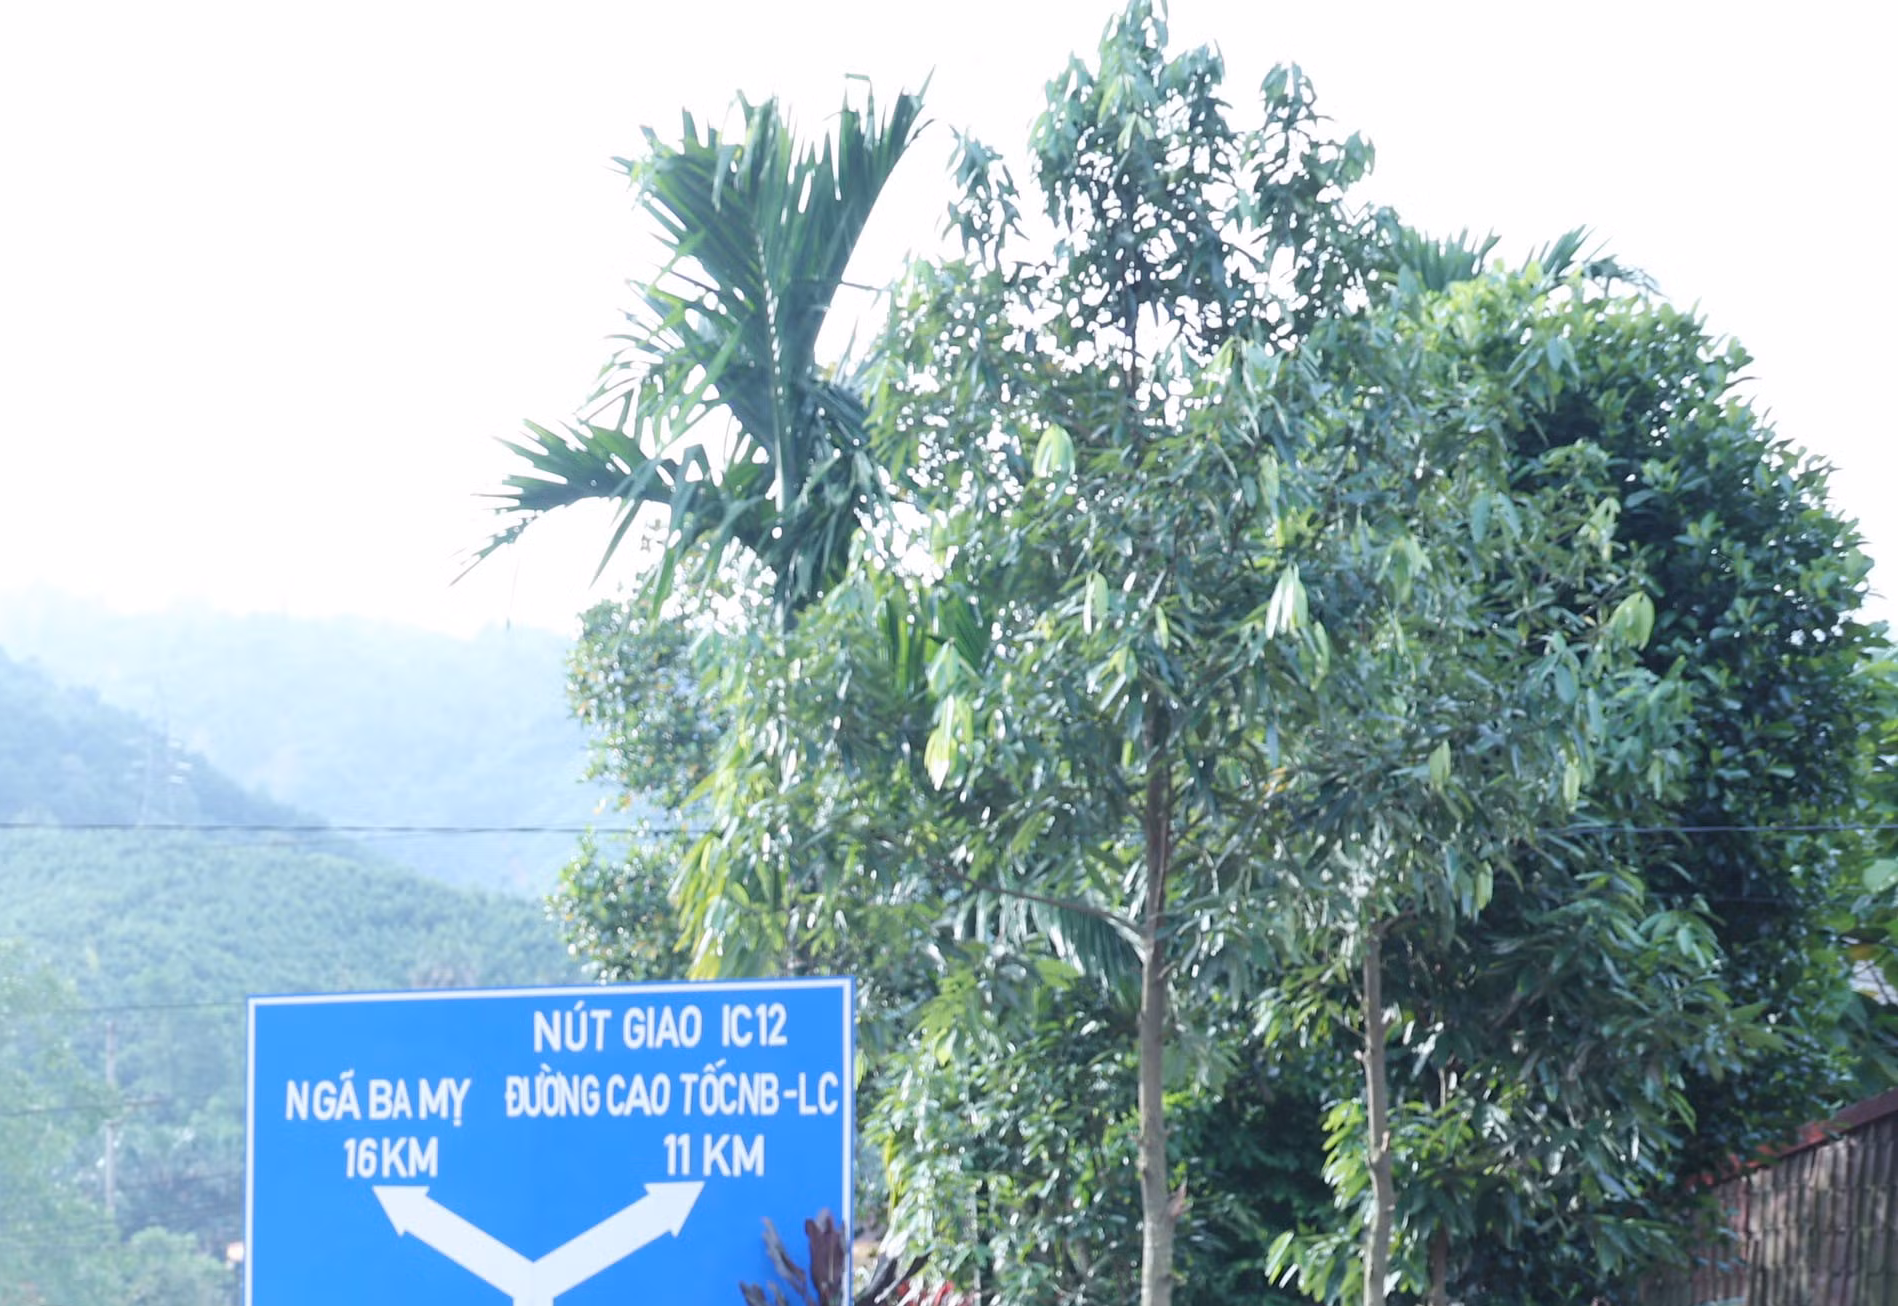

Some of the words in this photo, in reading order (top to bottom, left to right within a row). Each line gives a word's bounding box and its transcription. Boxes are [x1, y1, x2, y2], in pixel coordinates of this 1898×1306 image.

[534, 1000, 612, 1052] NÚT
[623, 1005, 702, 1049] GIAO
[722, 1003, 787, 1047] IC12
[286, 1070, 361, 1120] NGÃ
[369, 1079, 412, 1120] BA
[505, 1064, 600, 1117] ĐƯỜNG
[606, 1073, 670, 1116] CAO
[664, 1134, 690, 1175] 11
[703, 1134, 764, 1176] KM
